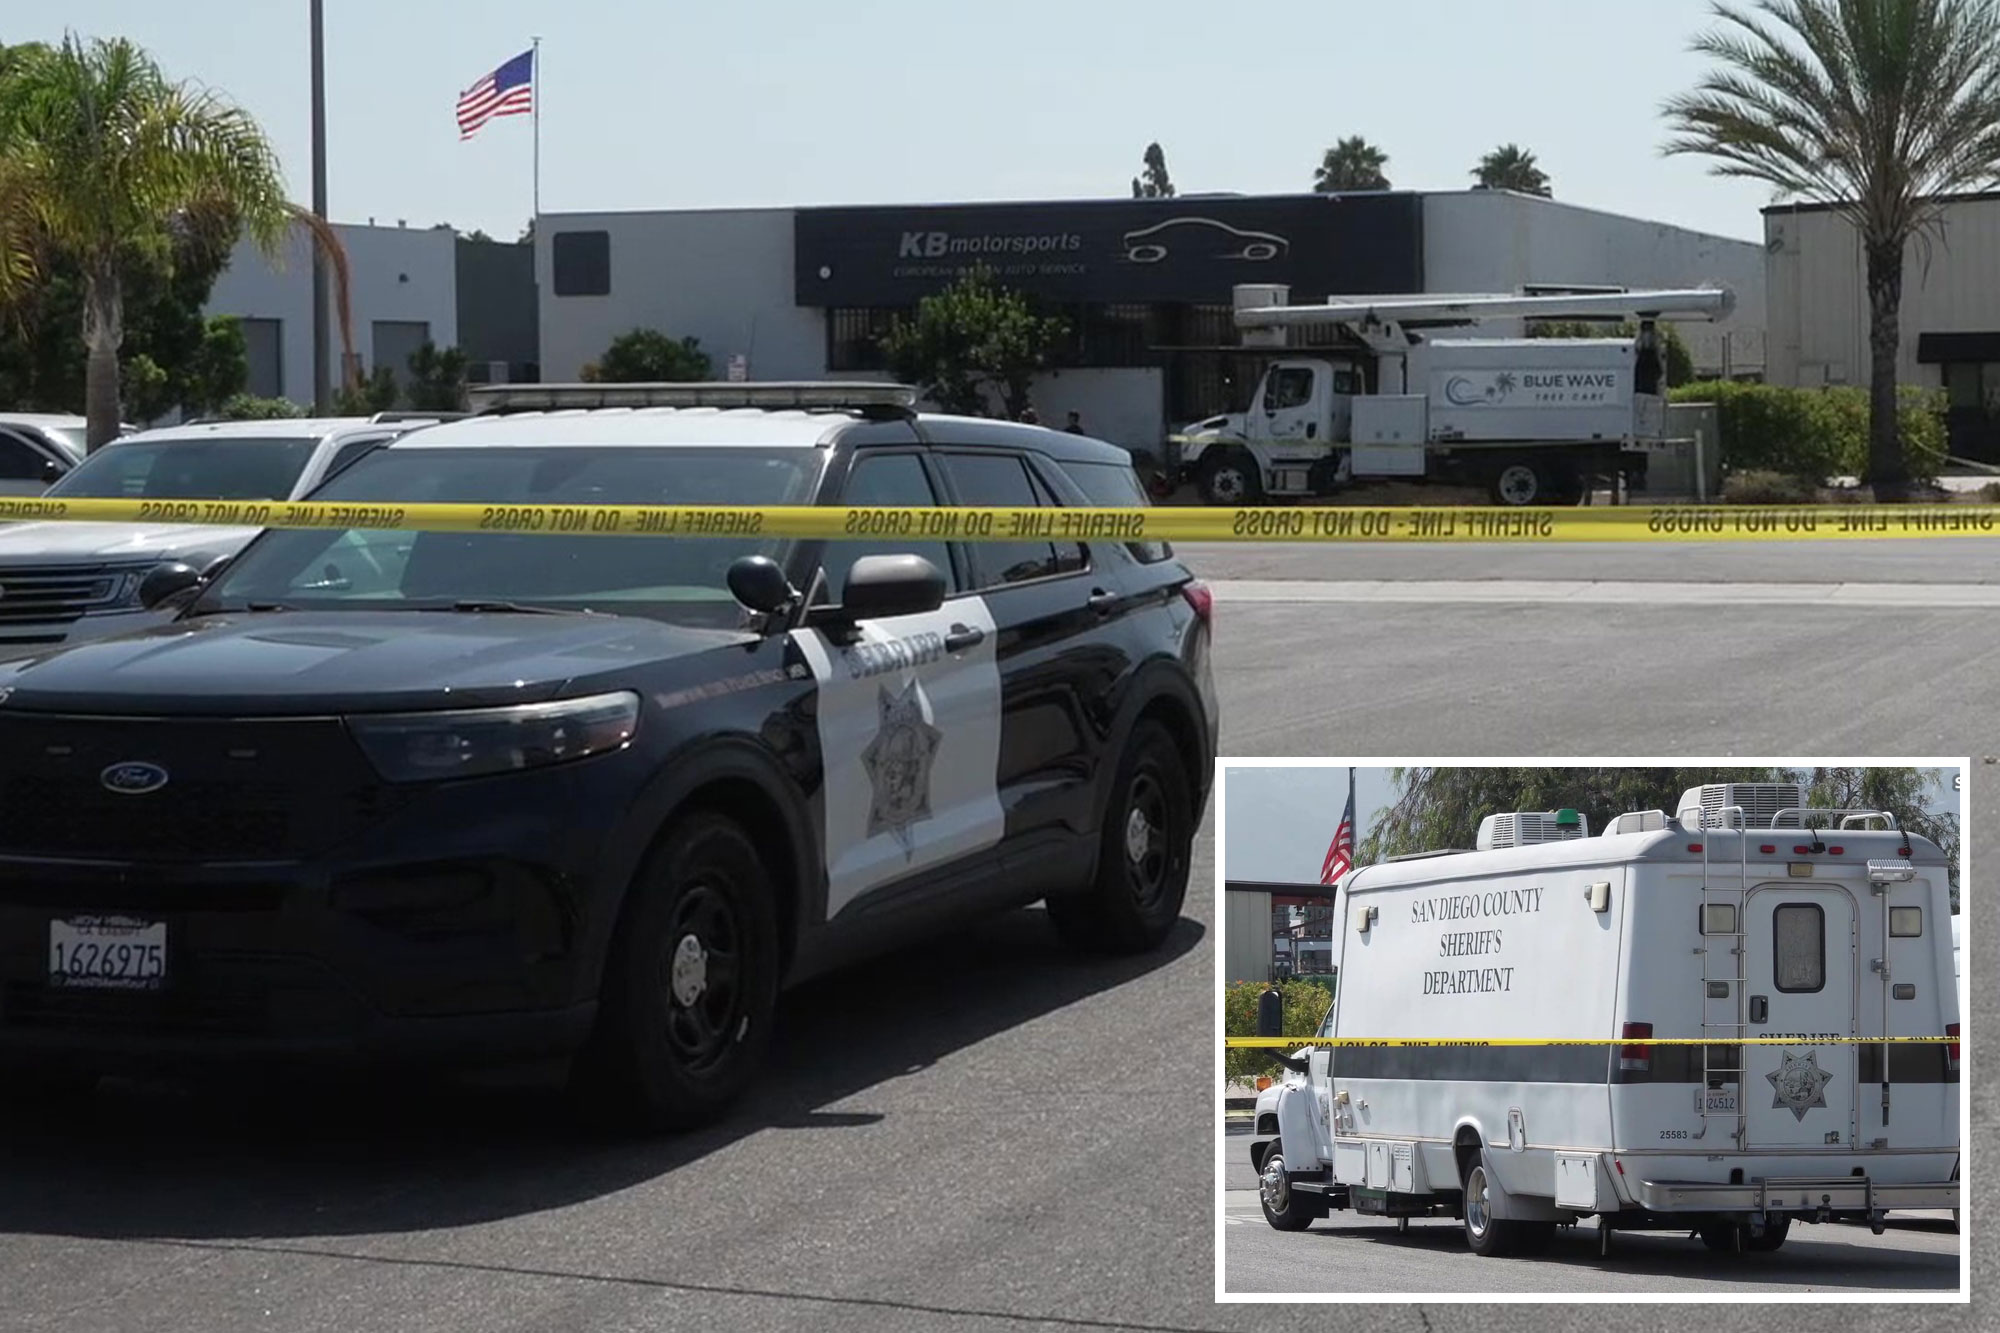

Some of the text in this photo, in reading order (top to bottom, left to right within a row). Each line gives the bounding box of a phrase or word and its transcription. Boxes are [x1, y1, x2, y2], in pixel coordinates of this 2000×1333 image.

[1524, 374, 1615, 387] BLUE WAVE
[1411, 887, 1544, 924] SAN DIEGO COUNTY
[1439, 929, 1503, 958] SHERIFF'S
[54, 941, 162, 978] 1626975
[1423, 967, 1514, 996] DEPARTMENT
[1697, 1097, 1735, 1110] 124512
[1660, 1130, 1688, 1140] 25583
